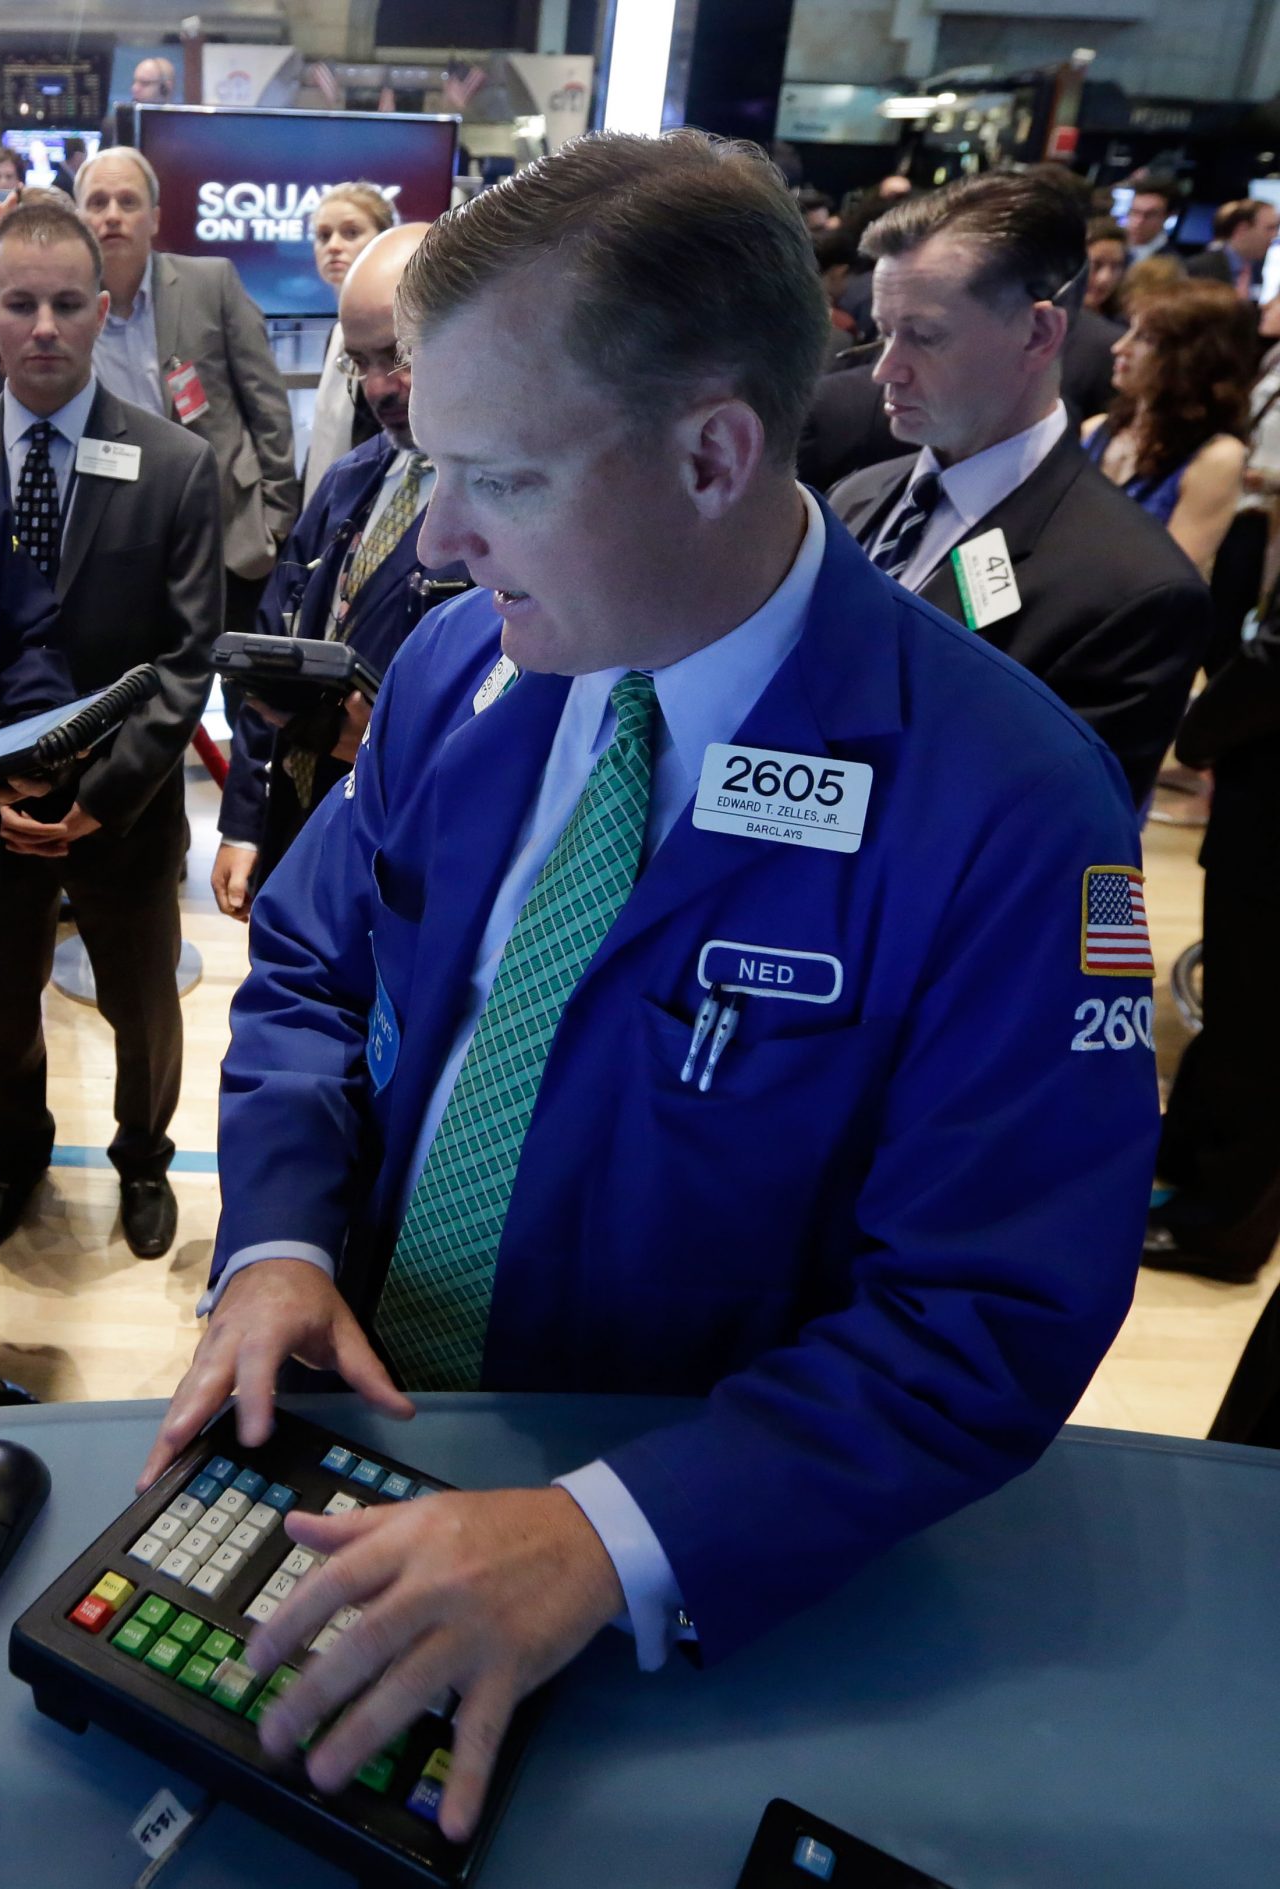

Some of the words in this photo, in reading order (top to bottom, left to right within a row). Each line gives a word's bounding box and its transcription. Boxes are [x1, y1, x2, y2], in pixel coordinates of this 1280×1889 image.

[197, 181, 402, 218] SQUA
[195, 218, 243, 241] ON
[251, 219, 303, 241] THE
[986, 556, 1012, 595] 471
[481, 661, 504, 698] 3979
[721, 755, 845, 806] 2605
[717, 796, 761, 812] EDWARD
[766, 803, 773, 815] T.
[824, 813, 840, 825] JR.
[746, 823, 803, 840] BARCLAYS
[738, 958, 794, 985] NED
[210, 1516, 219, 1525] 8
[192, 1538, 201, 1546] 5
[239, 1532, 249, 1541] 7
[142, 1543, 152, 1552] 3
[221, 1552, 232, 1561] 4
[171, 1558, 182, 1568] 2
